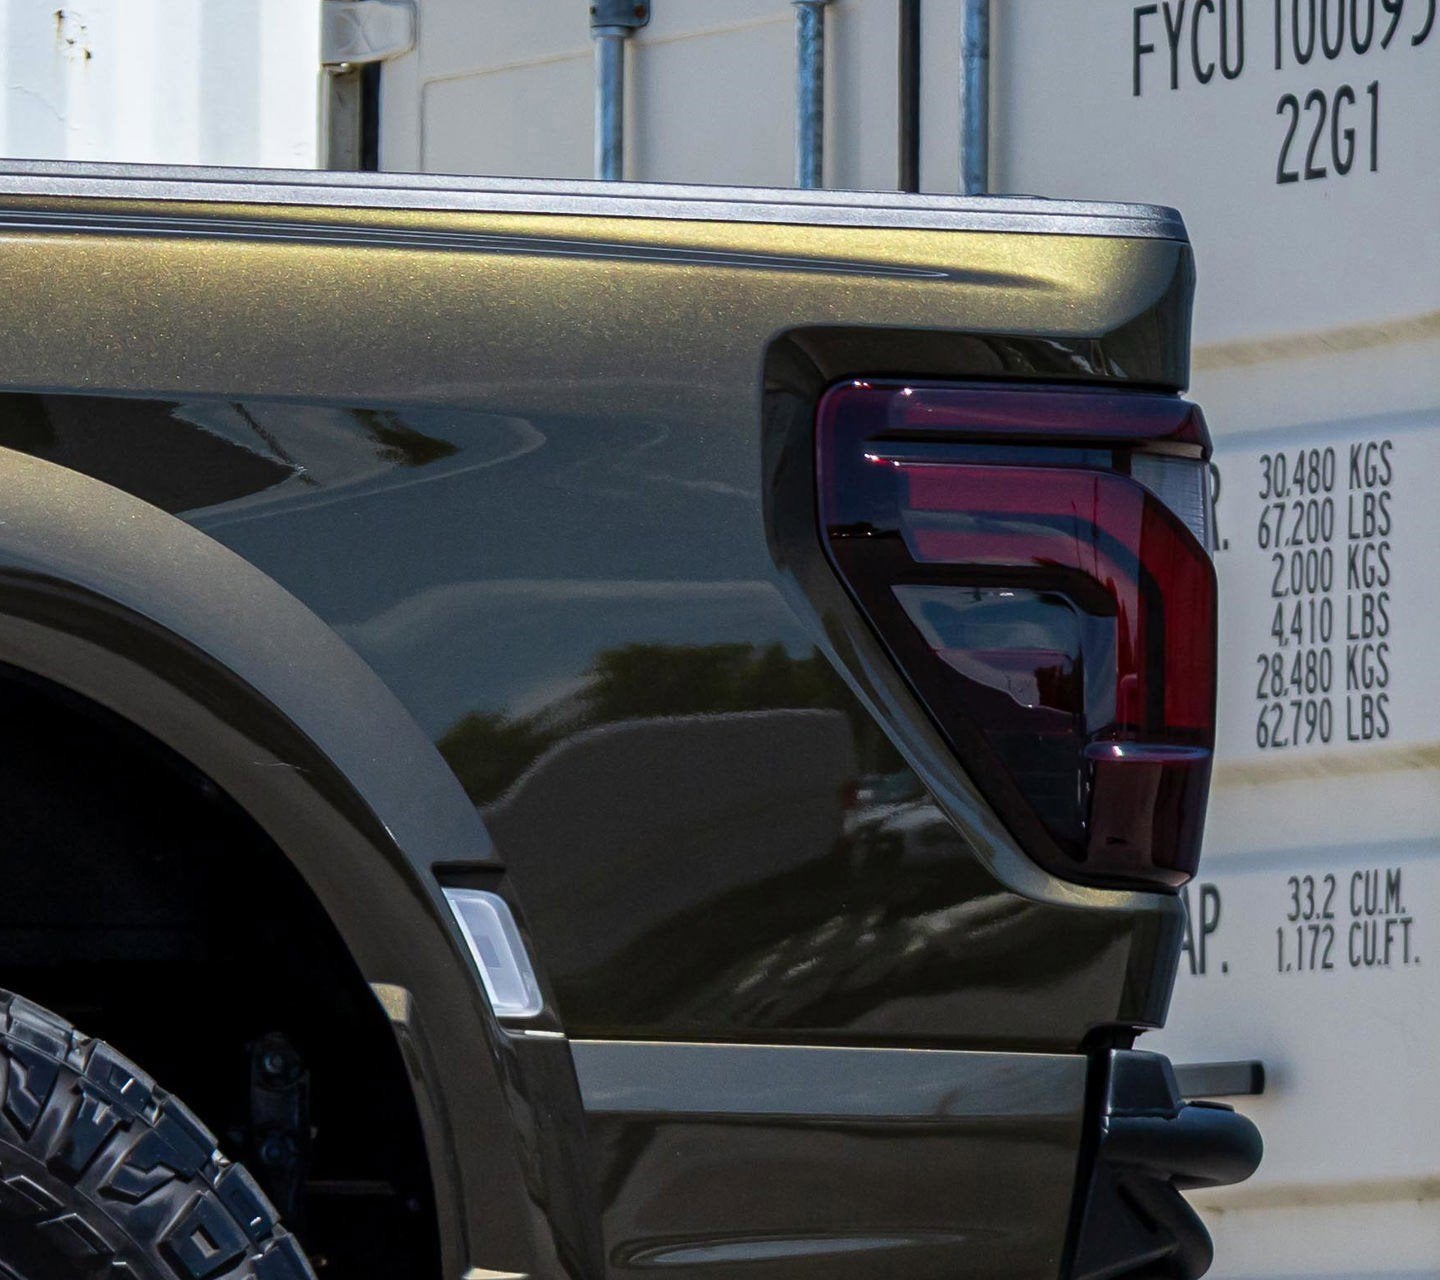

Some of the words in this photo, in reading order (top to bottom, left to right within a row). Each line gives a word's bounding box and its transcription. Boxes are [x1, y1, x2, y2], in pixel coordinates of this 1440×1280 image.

[1276, 81, 1378, 184] 22G1
[1349, 440, 1392, 490] KGS
[1348, 490, 1391, 540] LBS
[1348, 541, 1391, 590] KGS
[1347, 592, 1390, 640] LBS
[1346, 642, 1389, 690] KGS
[1347, 692, 1389, 741] LBS
[1181, 883, 1228, 975] AP.
[1287, 873, 1336, 921] 33.2
[1350, 867, 1406, 917] CU.M.
[1348, 917, 1420, 967] CU.FT.
